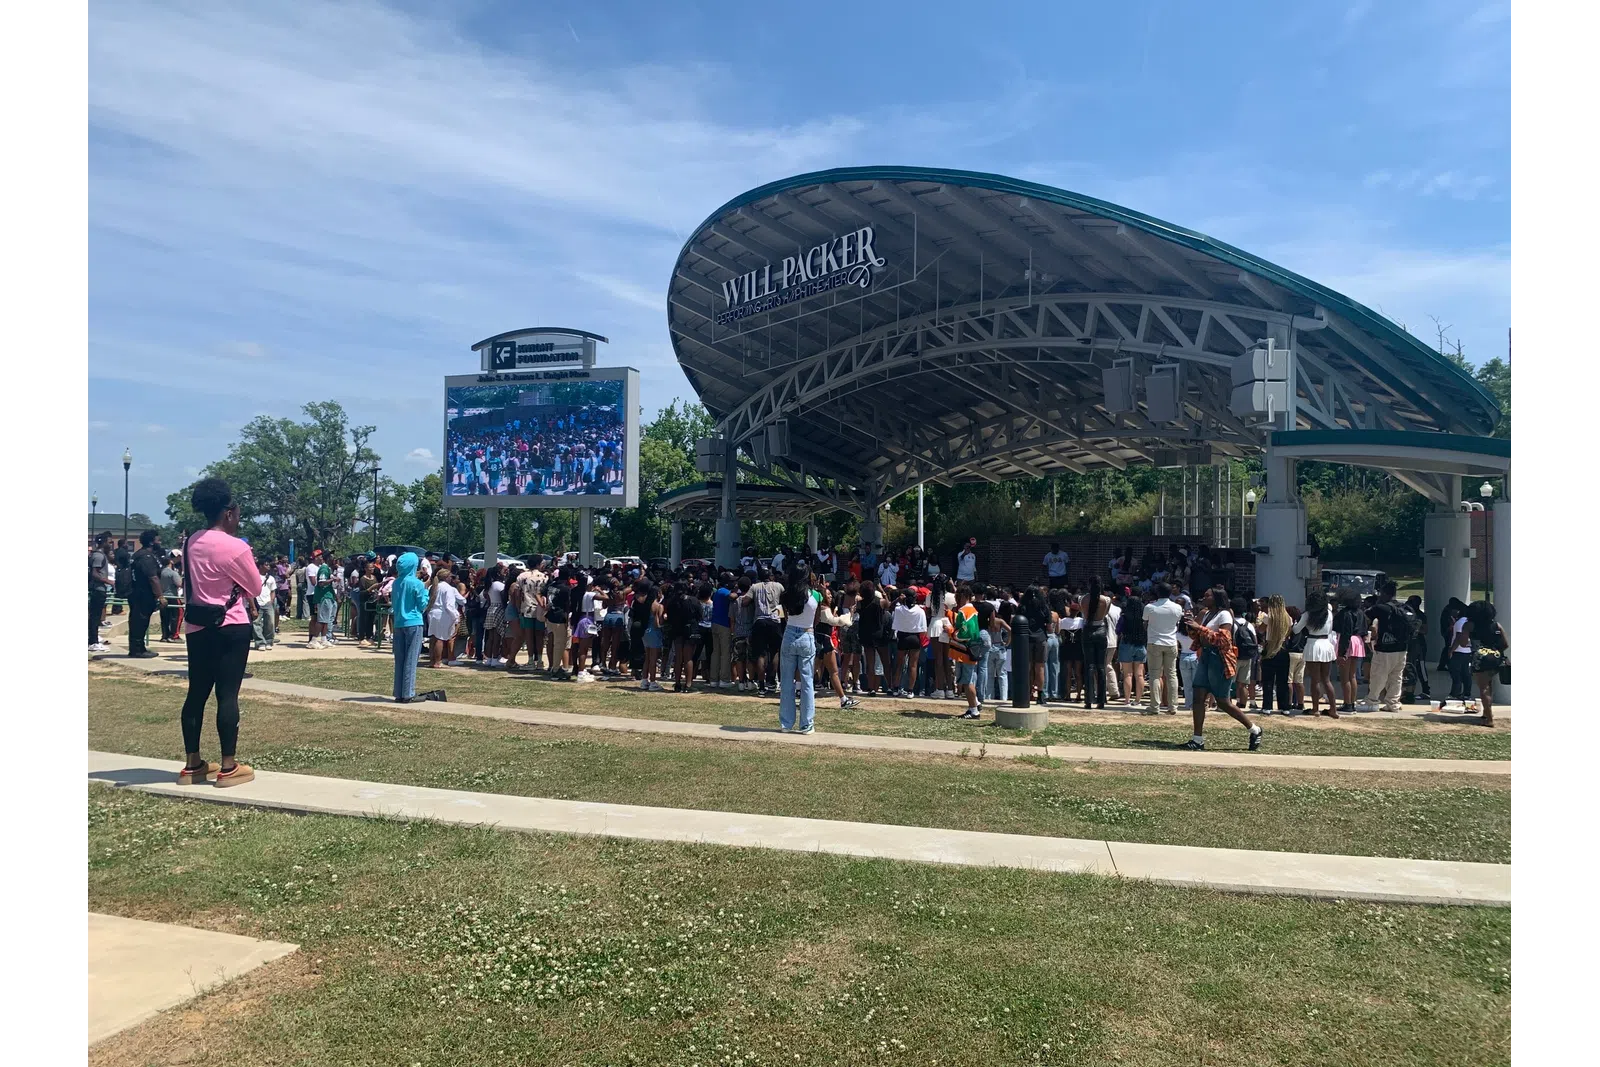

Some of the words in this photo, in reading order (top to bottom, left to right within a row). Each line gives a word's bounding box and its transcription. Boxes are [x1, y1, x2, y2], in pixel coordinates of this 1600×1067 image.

[722, 264, 776, 308] WILL
[782, 227, 886, 288] PACKER
[716, 300, 762, 326] PERFORMING
[762, 294, 782, 312] ARTS
[783, 271, 848, 304] AMPHITHEATER
[517, 343, 554, 353] KNIGHT
[517, 352, 579, 364] FOUNDATION
